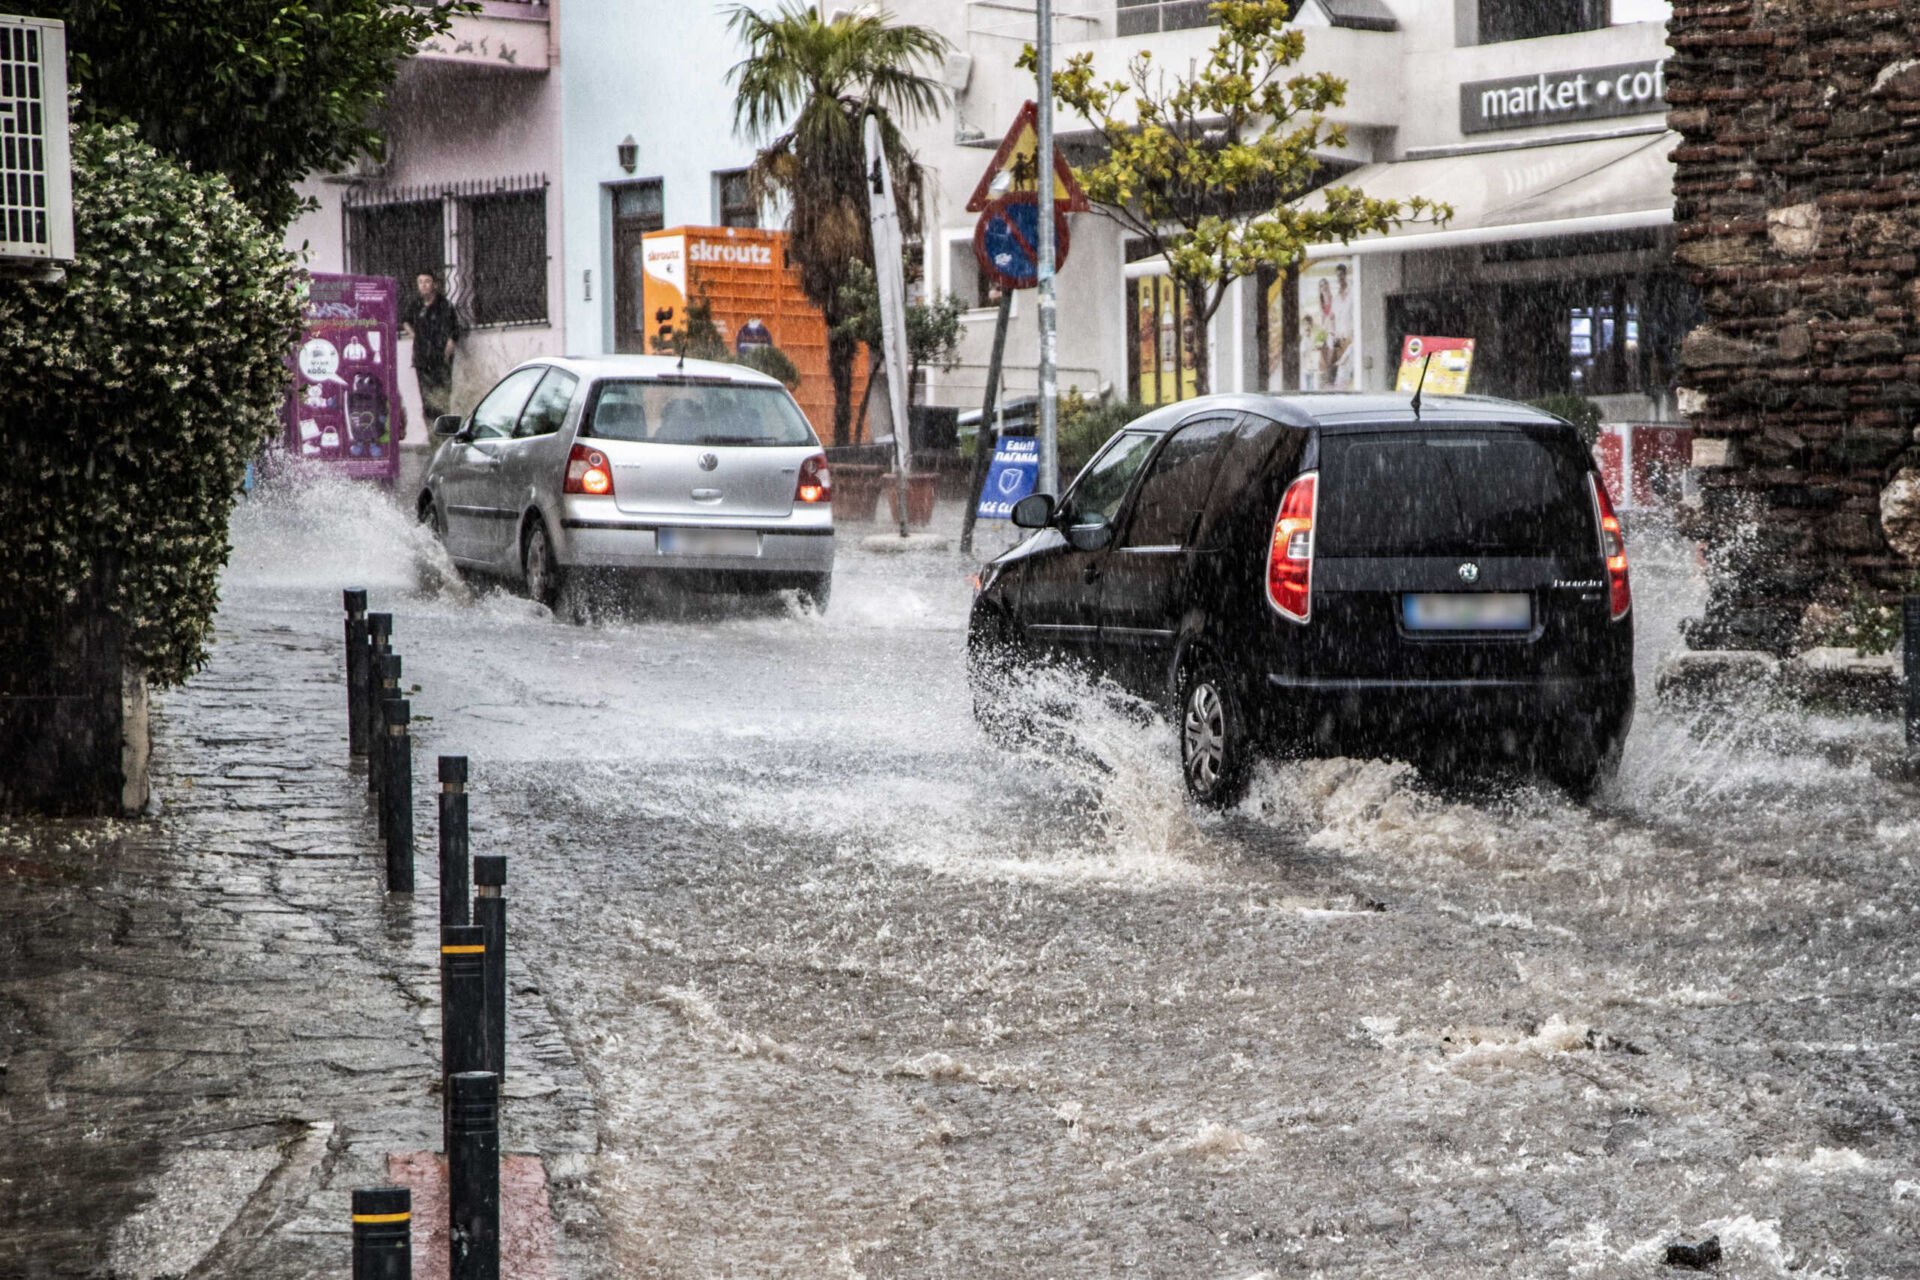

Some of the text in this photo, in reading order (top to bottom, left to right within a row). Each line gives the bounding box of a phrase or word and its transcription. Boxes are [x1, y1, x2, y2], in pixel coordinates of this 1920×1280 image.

[1481, 73, 1588, 117] market
[689, 239, 771, 264] skroutz
[978, 501, 997, 513] ICE
